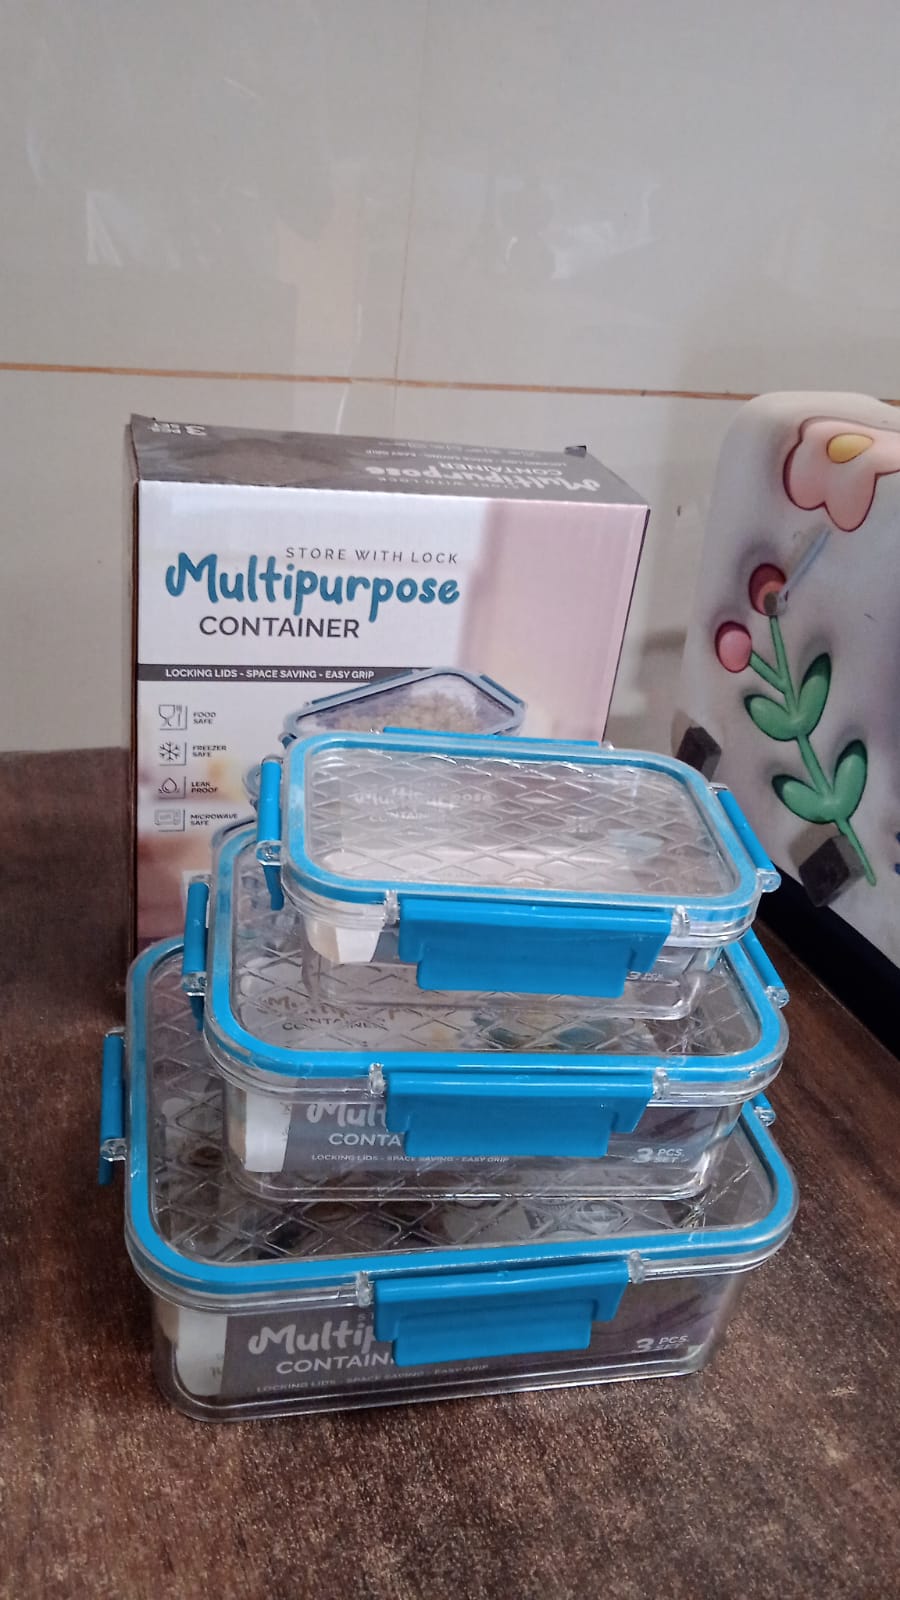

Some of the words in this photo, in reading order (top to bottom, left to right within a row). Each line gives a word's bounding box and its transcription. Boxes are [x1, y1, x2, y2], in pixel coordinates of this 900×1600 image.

[439, 462, 564, 476] CONTAINER
[365, 465, 600, 492] Multipurpose
[286, 547, 347, 561] STORE
[355, 549, 403, 563] WITH
[411, 551, 458, 564] LOCK
[165, 552, 460, 623] Multipurpose
[199, 616, 360, 639] CONTAINER
[165, 668, 213, 678] LOCKING
[214, 669, 238, 678] LIDS
[246, 669, 278, 679] SPACE
[280, 669, 317, 679] SAVING
[325, 670, 351, 679] EASY
[351, 670, 375, 680] GRIP
[632, 1147, 653, 1163] 3
[632, 1337, 654, 1353] 3
[276, 1352, 395, 1374] CONTAIN
